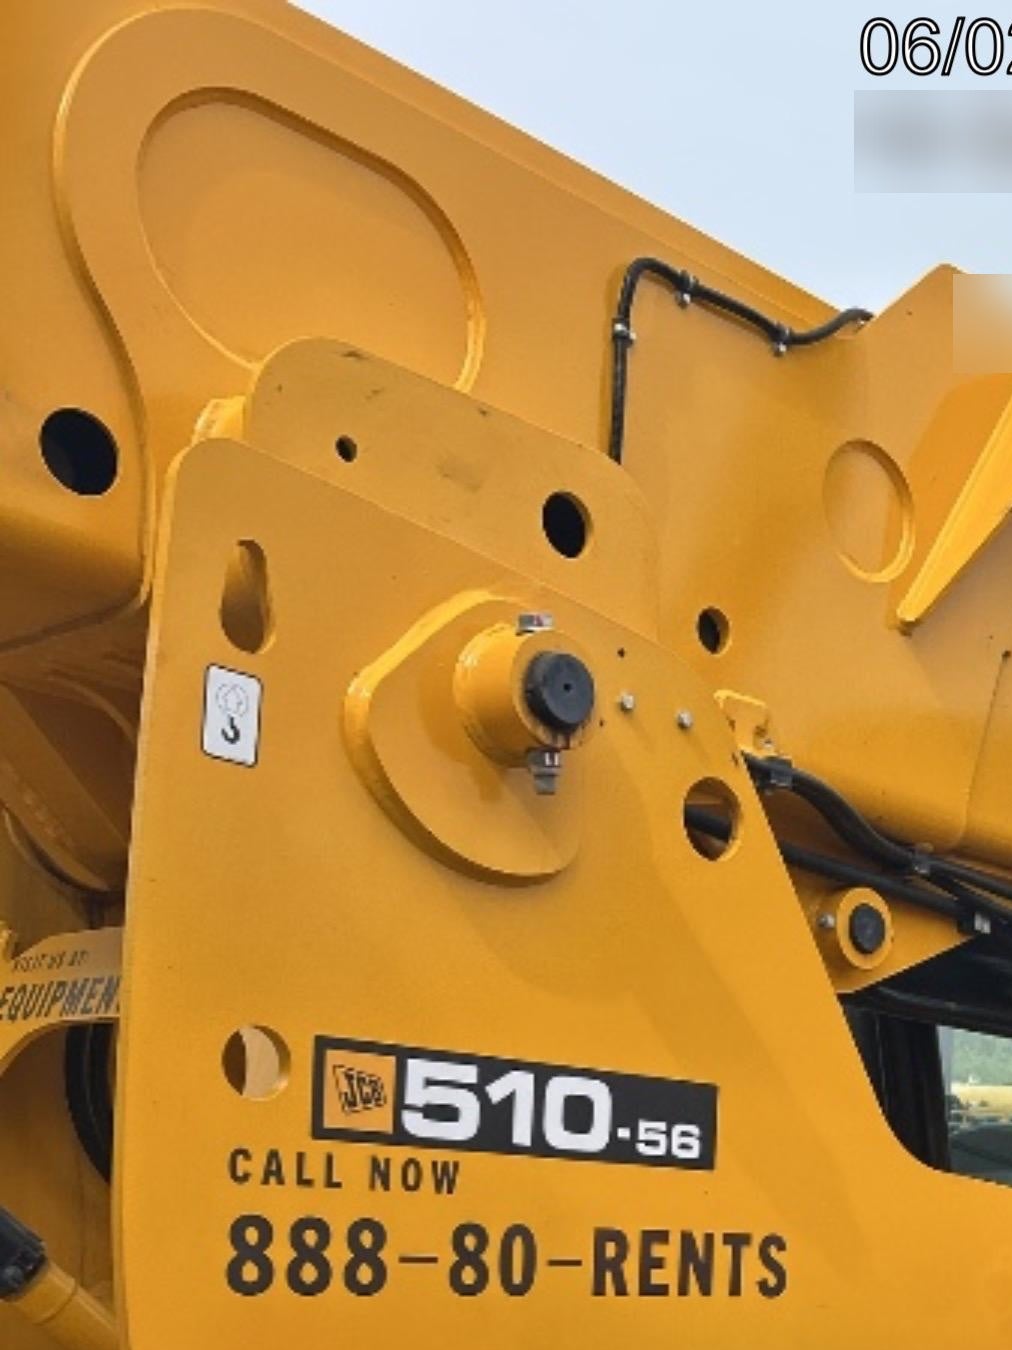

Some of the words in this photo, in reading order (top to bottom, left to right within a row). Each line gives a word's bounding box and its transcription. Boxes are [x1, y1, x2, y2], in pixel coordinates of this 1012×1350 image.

[0, 976, 121, 1022] EQUIPMEN
[337, 1067, 386, 1112] JCB
[229, 1148, 342, 1189] CALL
[369, 1159, 461, 1195] NOW
[226, 1214, 788, 1299] 888-80-RENTS
